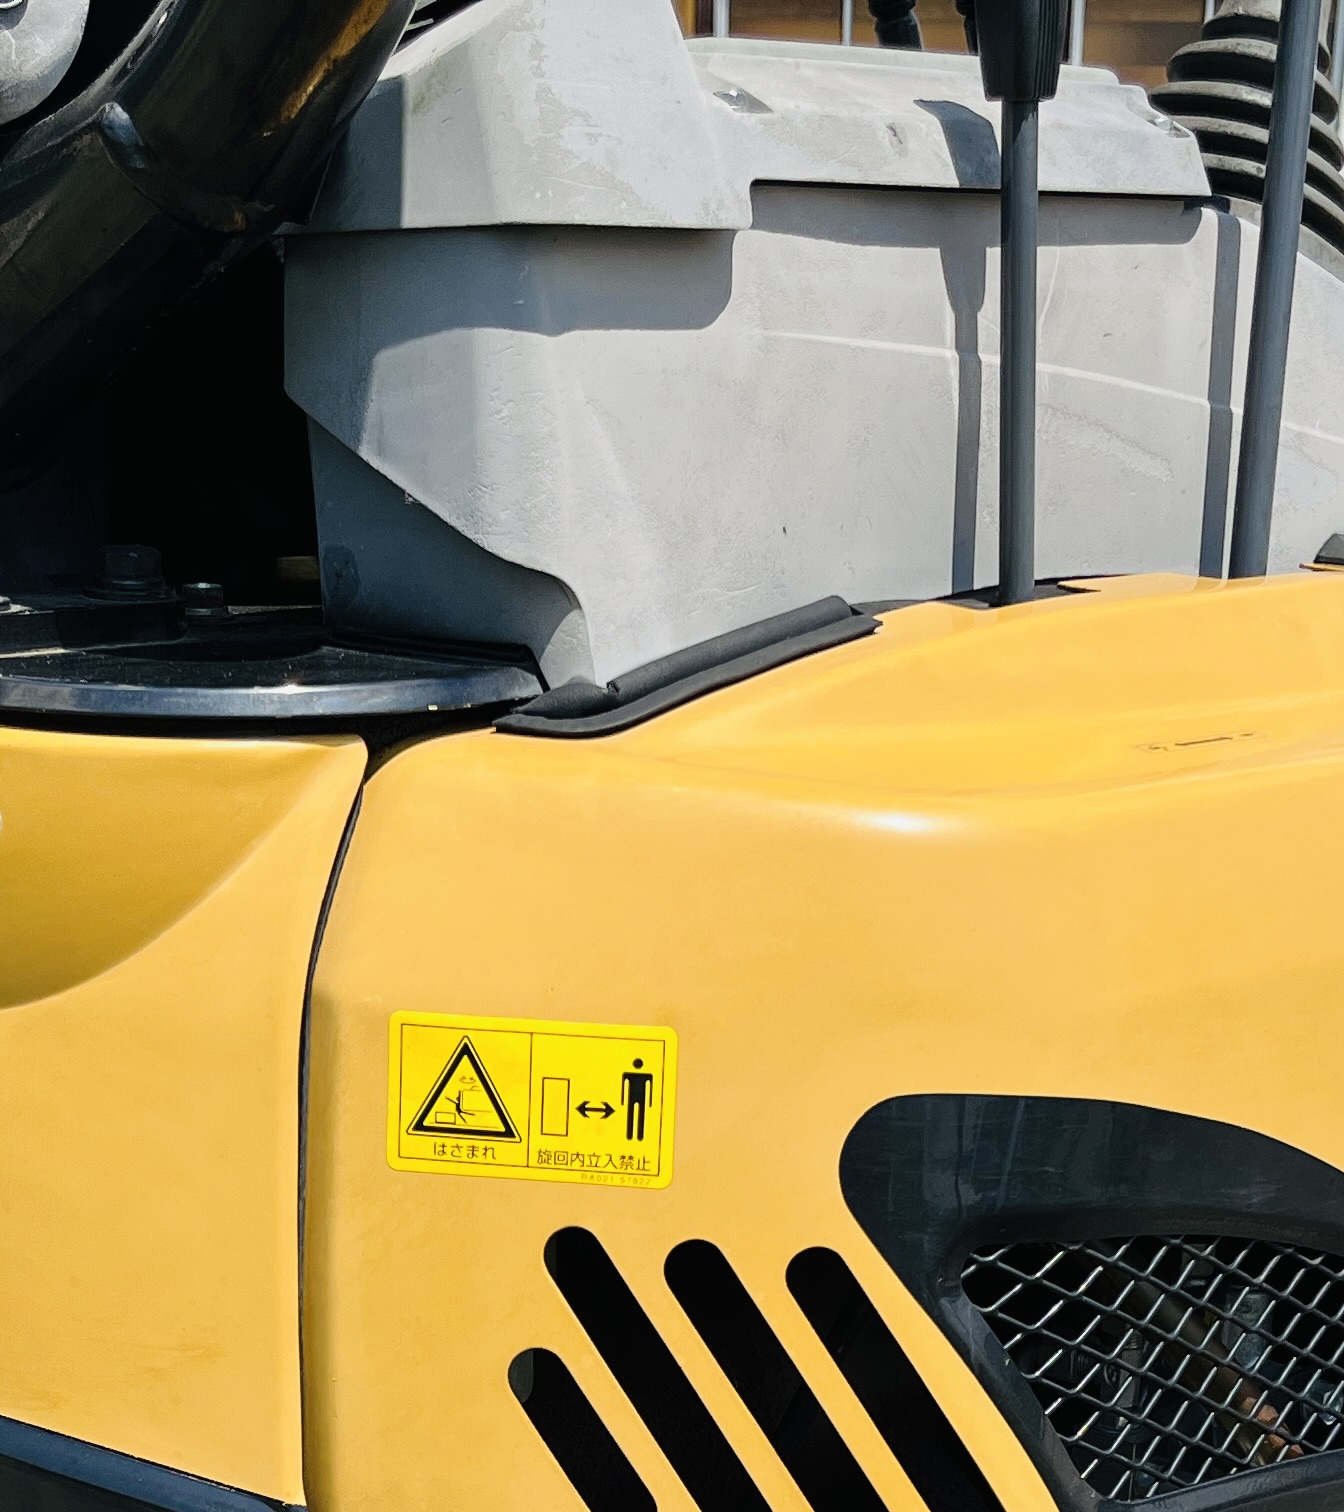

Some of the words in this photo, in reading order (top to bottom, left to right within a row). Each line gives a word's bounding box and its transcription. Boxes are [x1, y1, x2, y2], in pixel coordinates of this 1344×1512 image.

[433, 1141, 496, 1161] はさまれ
[536, 1148, 652, 1173] 旋回内立入禁止
